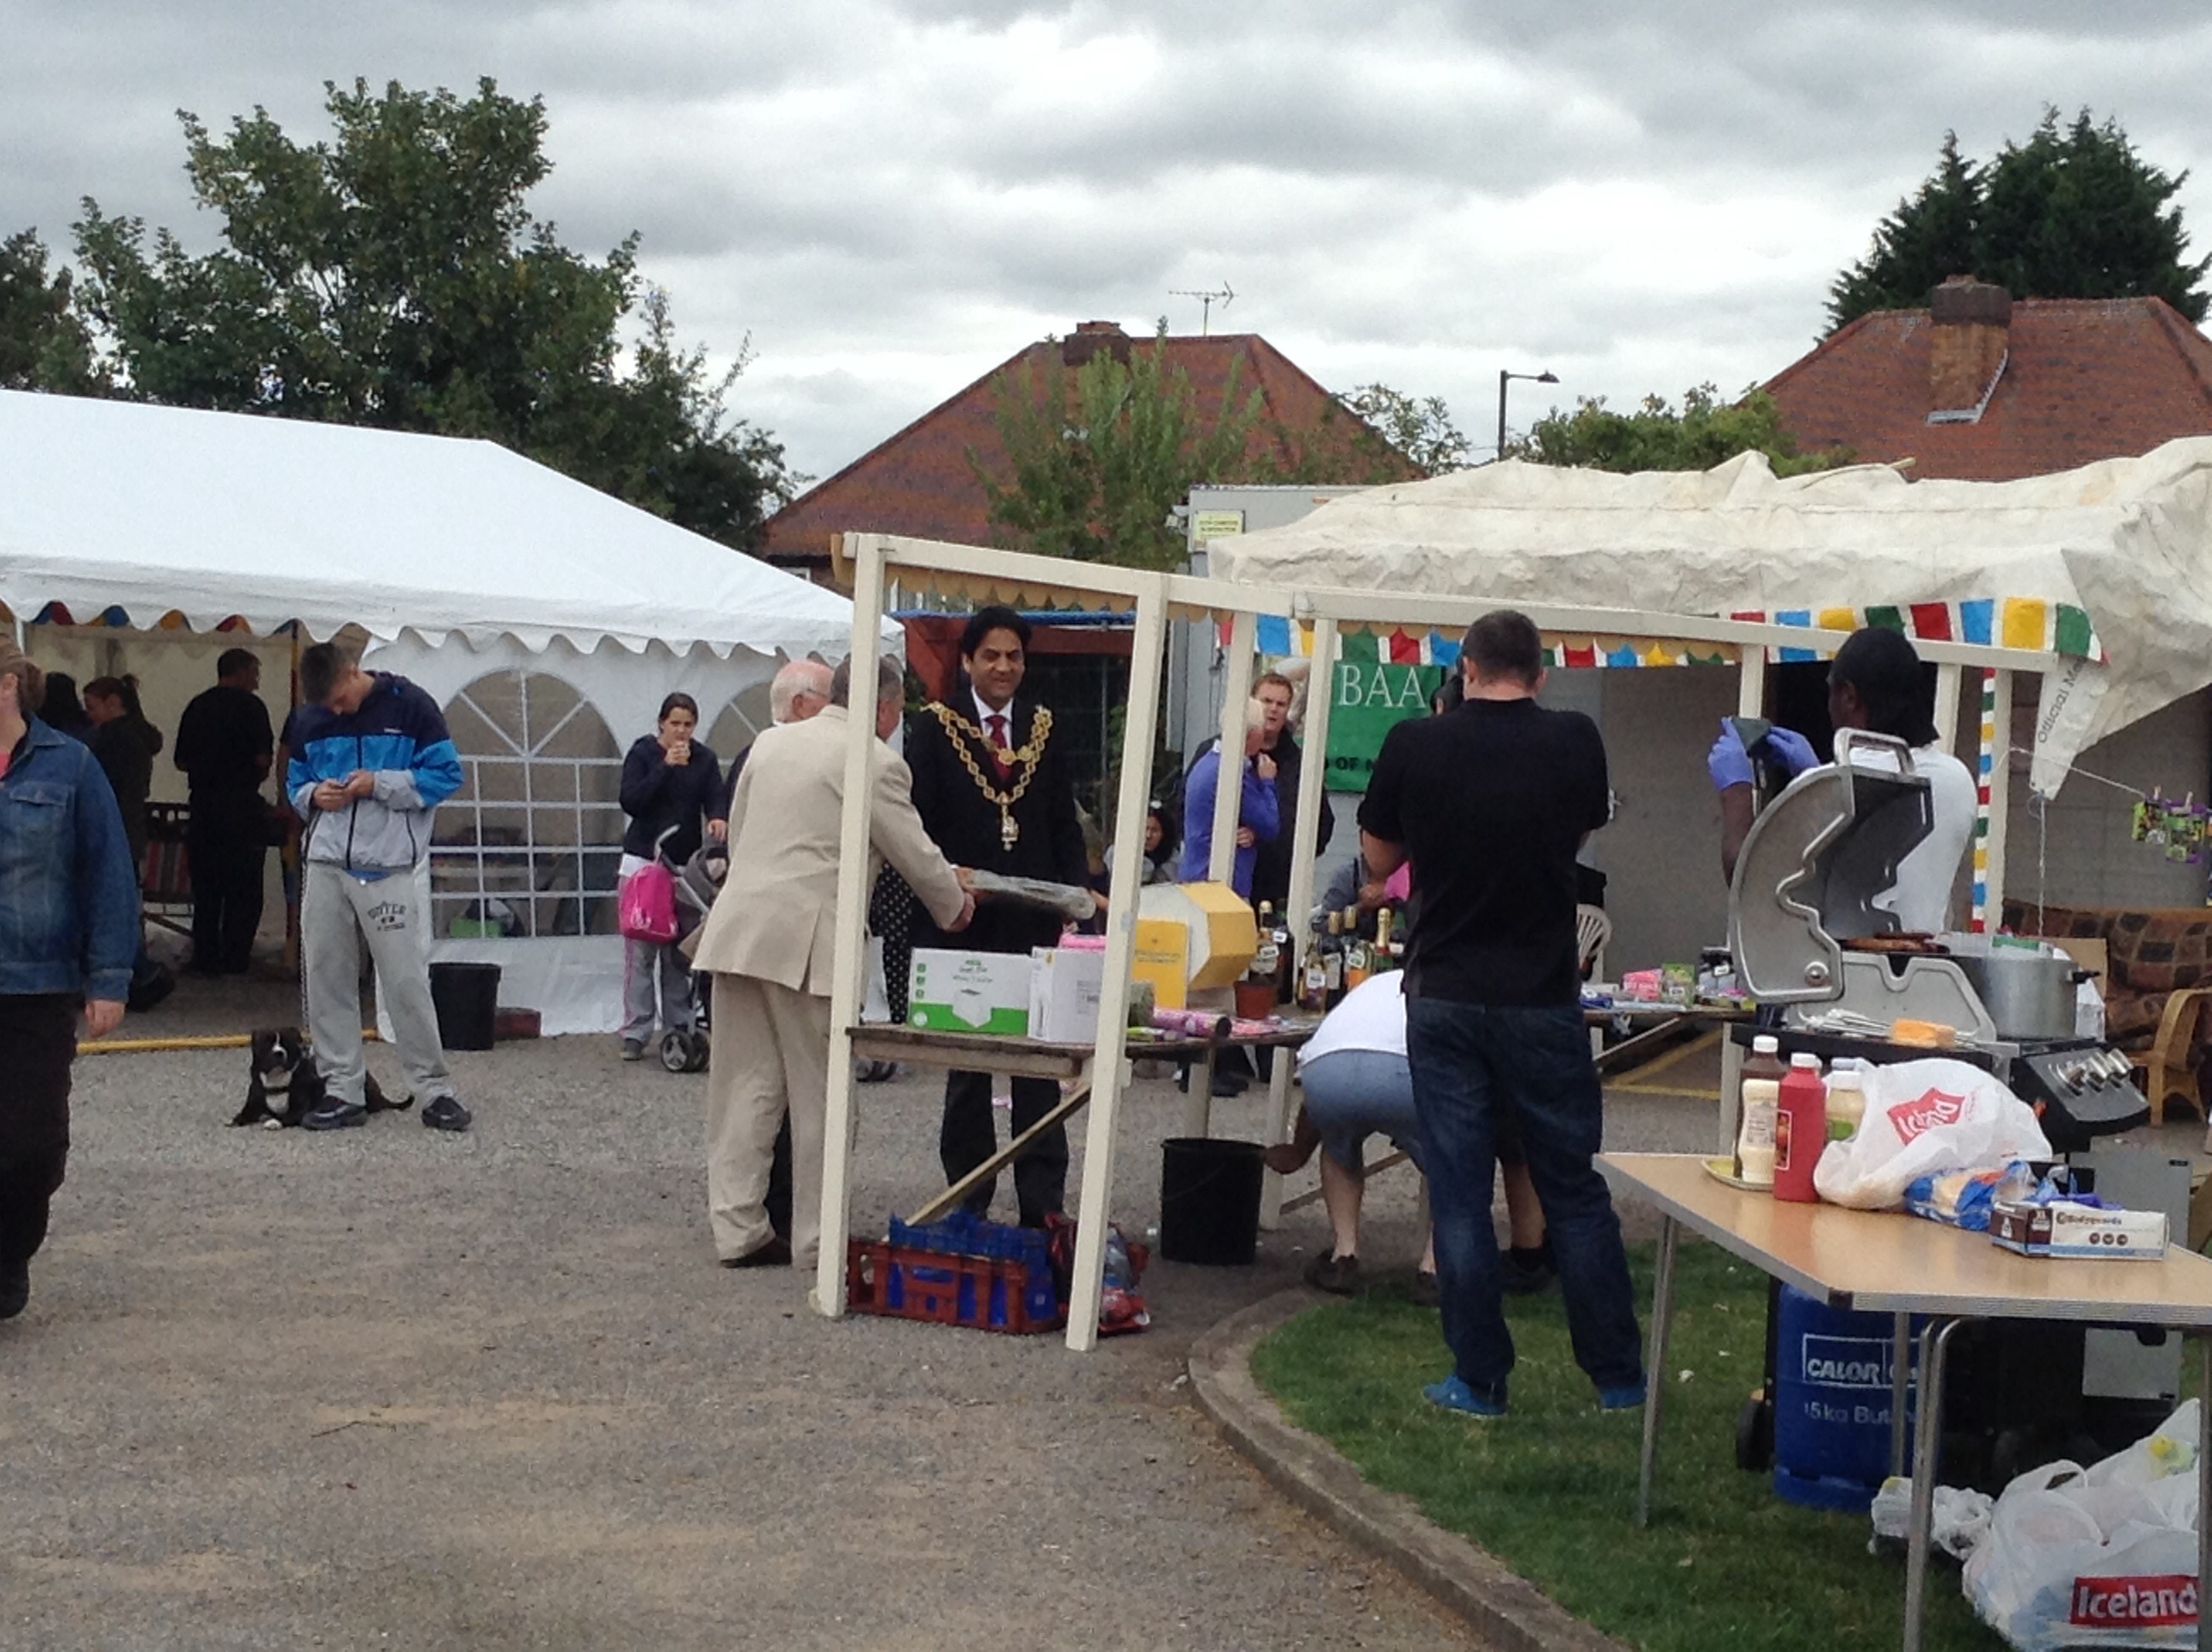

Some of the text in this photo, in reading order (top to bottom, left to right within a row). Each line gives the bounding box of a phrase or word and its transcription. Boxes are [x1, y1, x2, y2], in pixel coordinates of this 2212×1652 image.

[1338, 665, 1427, 708] BAA
[1897, 1098, 1959, 1138] Iclnd
[1807, 1358, 1881, 1386] CALOR
[2078, 1583, 2197, 1618] Iceland
